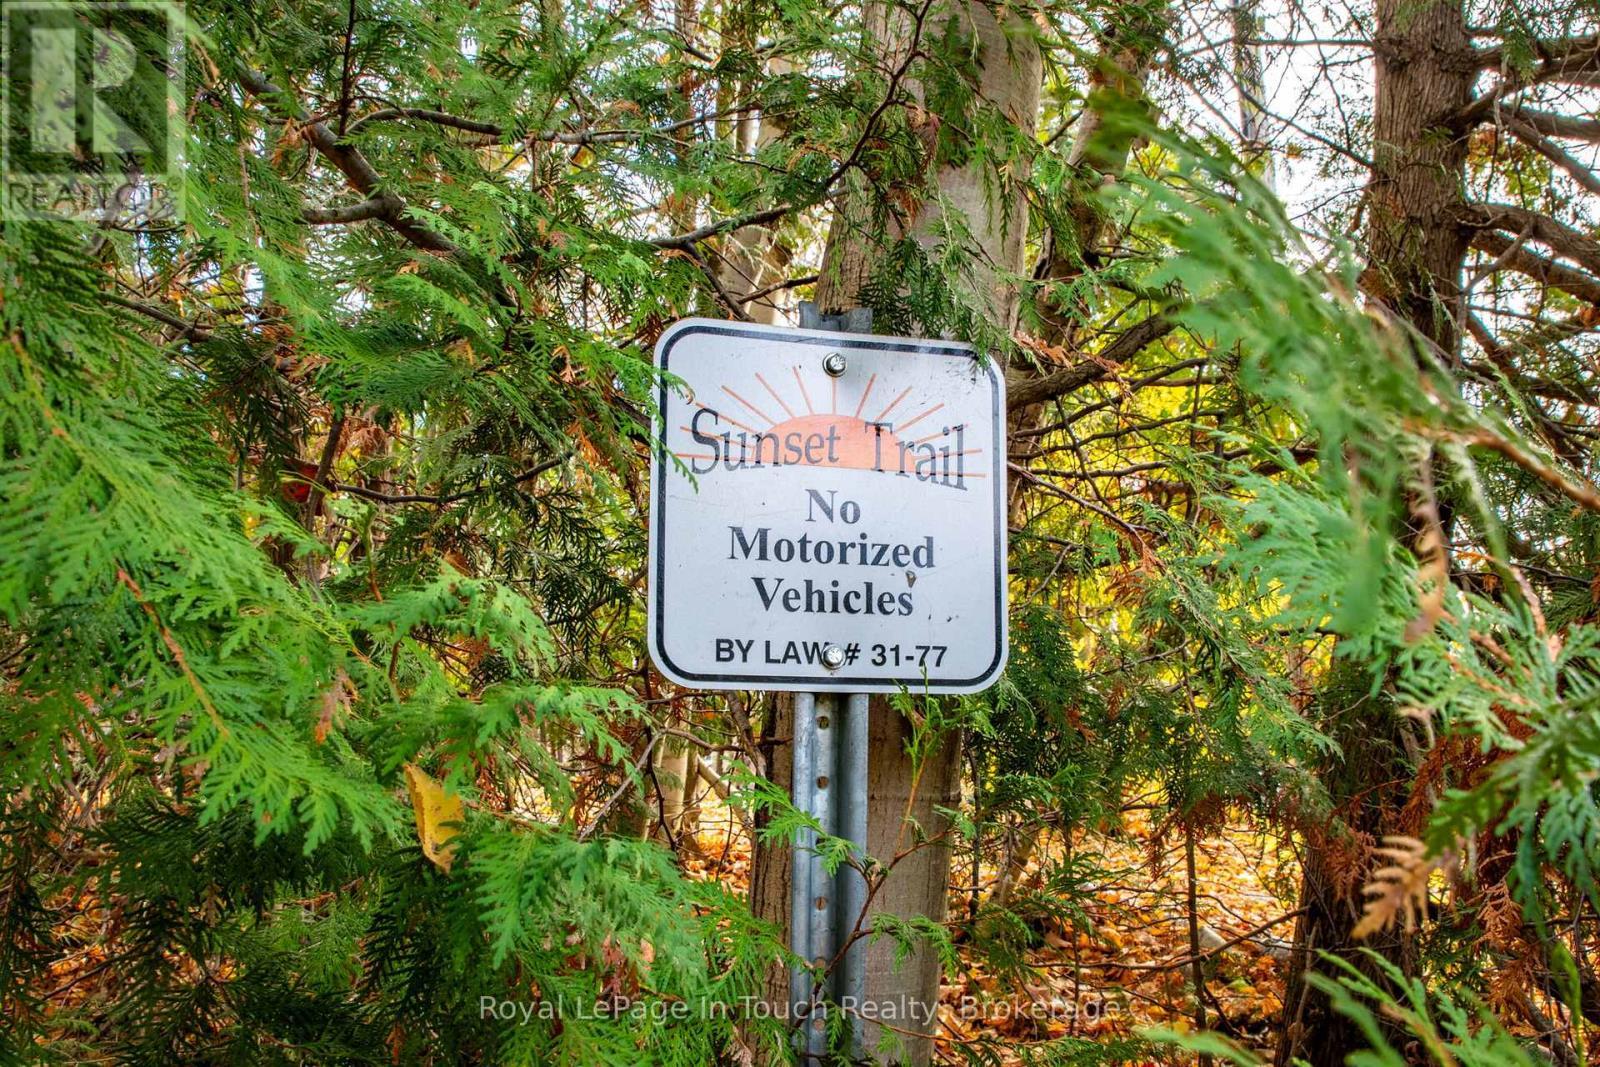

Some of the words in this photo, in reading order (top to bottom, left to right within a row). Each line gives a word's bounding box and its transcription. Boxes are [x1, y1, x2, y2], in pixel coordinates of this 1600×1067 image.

[691, 408, 841, 474] Sunset
[865, 421, 968, 491] Trail
[805, 489, 861, 524] No
[727, 526, 936, 569] Motorized
[751, 577, 914, 617] Vehicles
[715, 638, 755, 663] BY
[765, 640, 830, 665] LAW
[871, 644, 948, 668] 31-77
